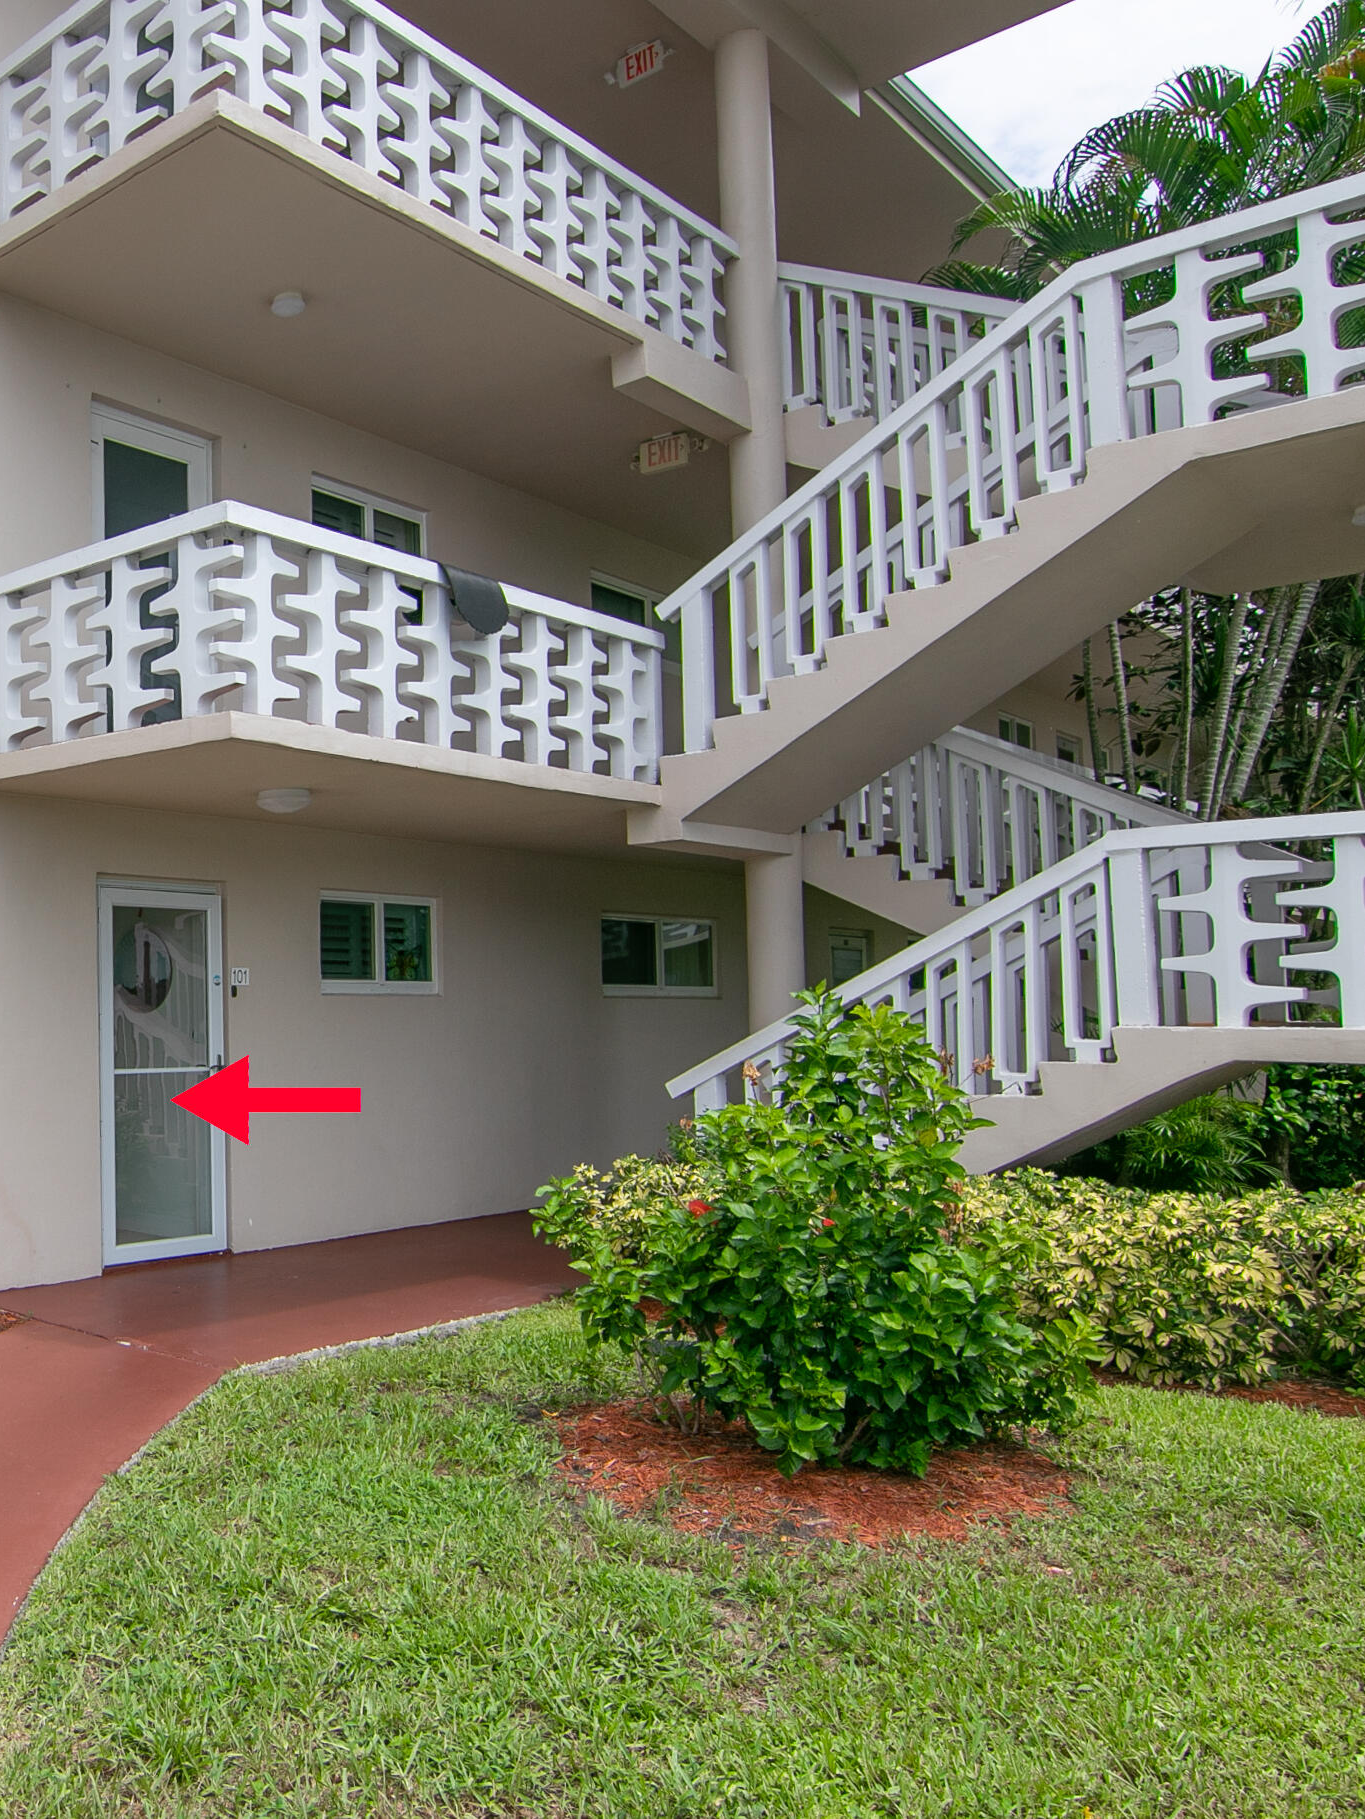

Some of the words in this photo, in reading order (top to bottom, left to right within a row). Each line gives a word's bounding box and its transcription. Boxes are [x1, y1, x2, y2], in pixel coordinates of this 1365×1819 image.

[626, 44, 655, 80] EXIT
[648, 436, 680, 467] EXIT
[233, 969, 247, 984] 101
